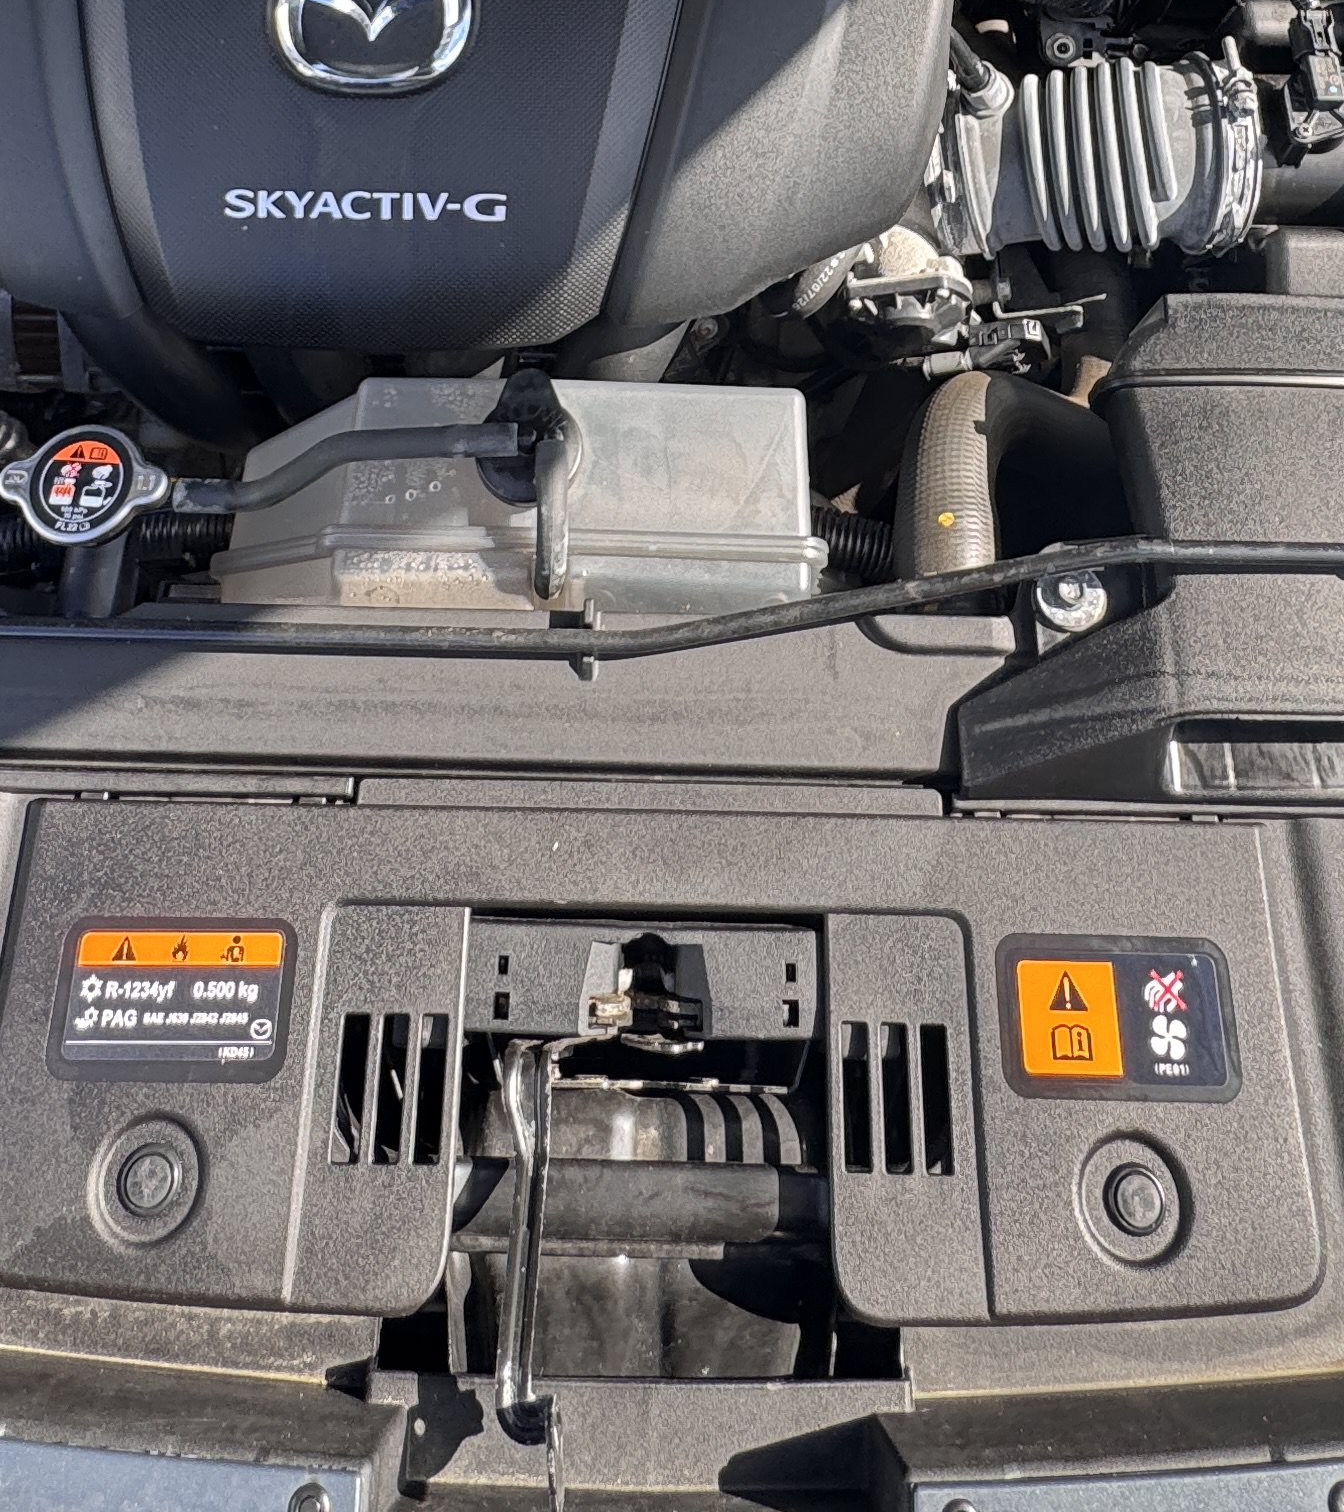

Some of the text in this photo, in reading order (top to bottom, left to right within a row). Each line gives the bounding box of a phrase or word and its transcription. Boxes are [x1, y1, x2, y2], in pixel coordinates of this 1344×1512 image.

[224, 188, 508, 222] SKYACTIV-G
[105, 980, 259, 1003] R-1234yf 0.500 kg
[101, 1008, 138, 1028] PAG
[1154, 1062, 1190, 1077] (PE01)
